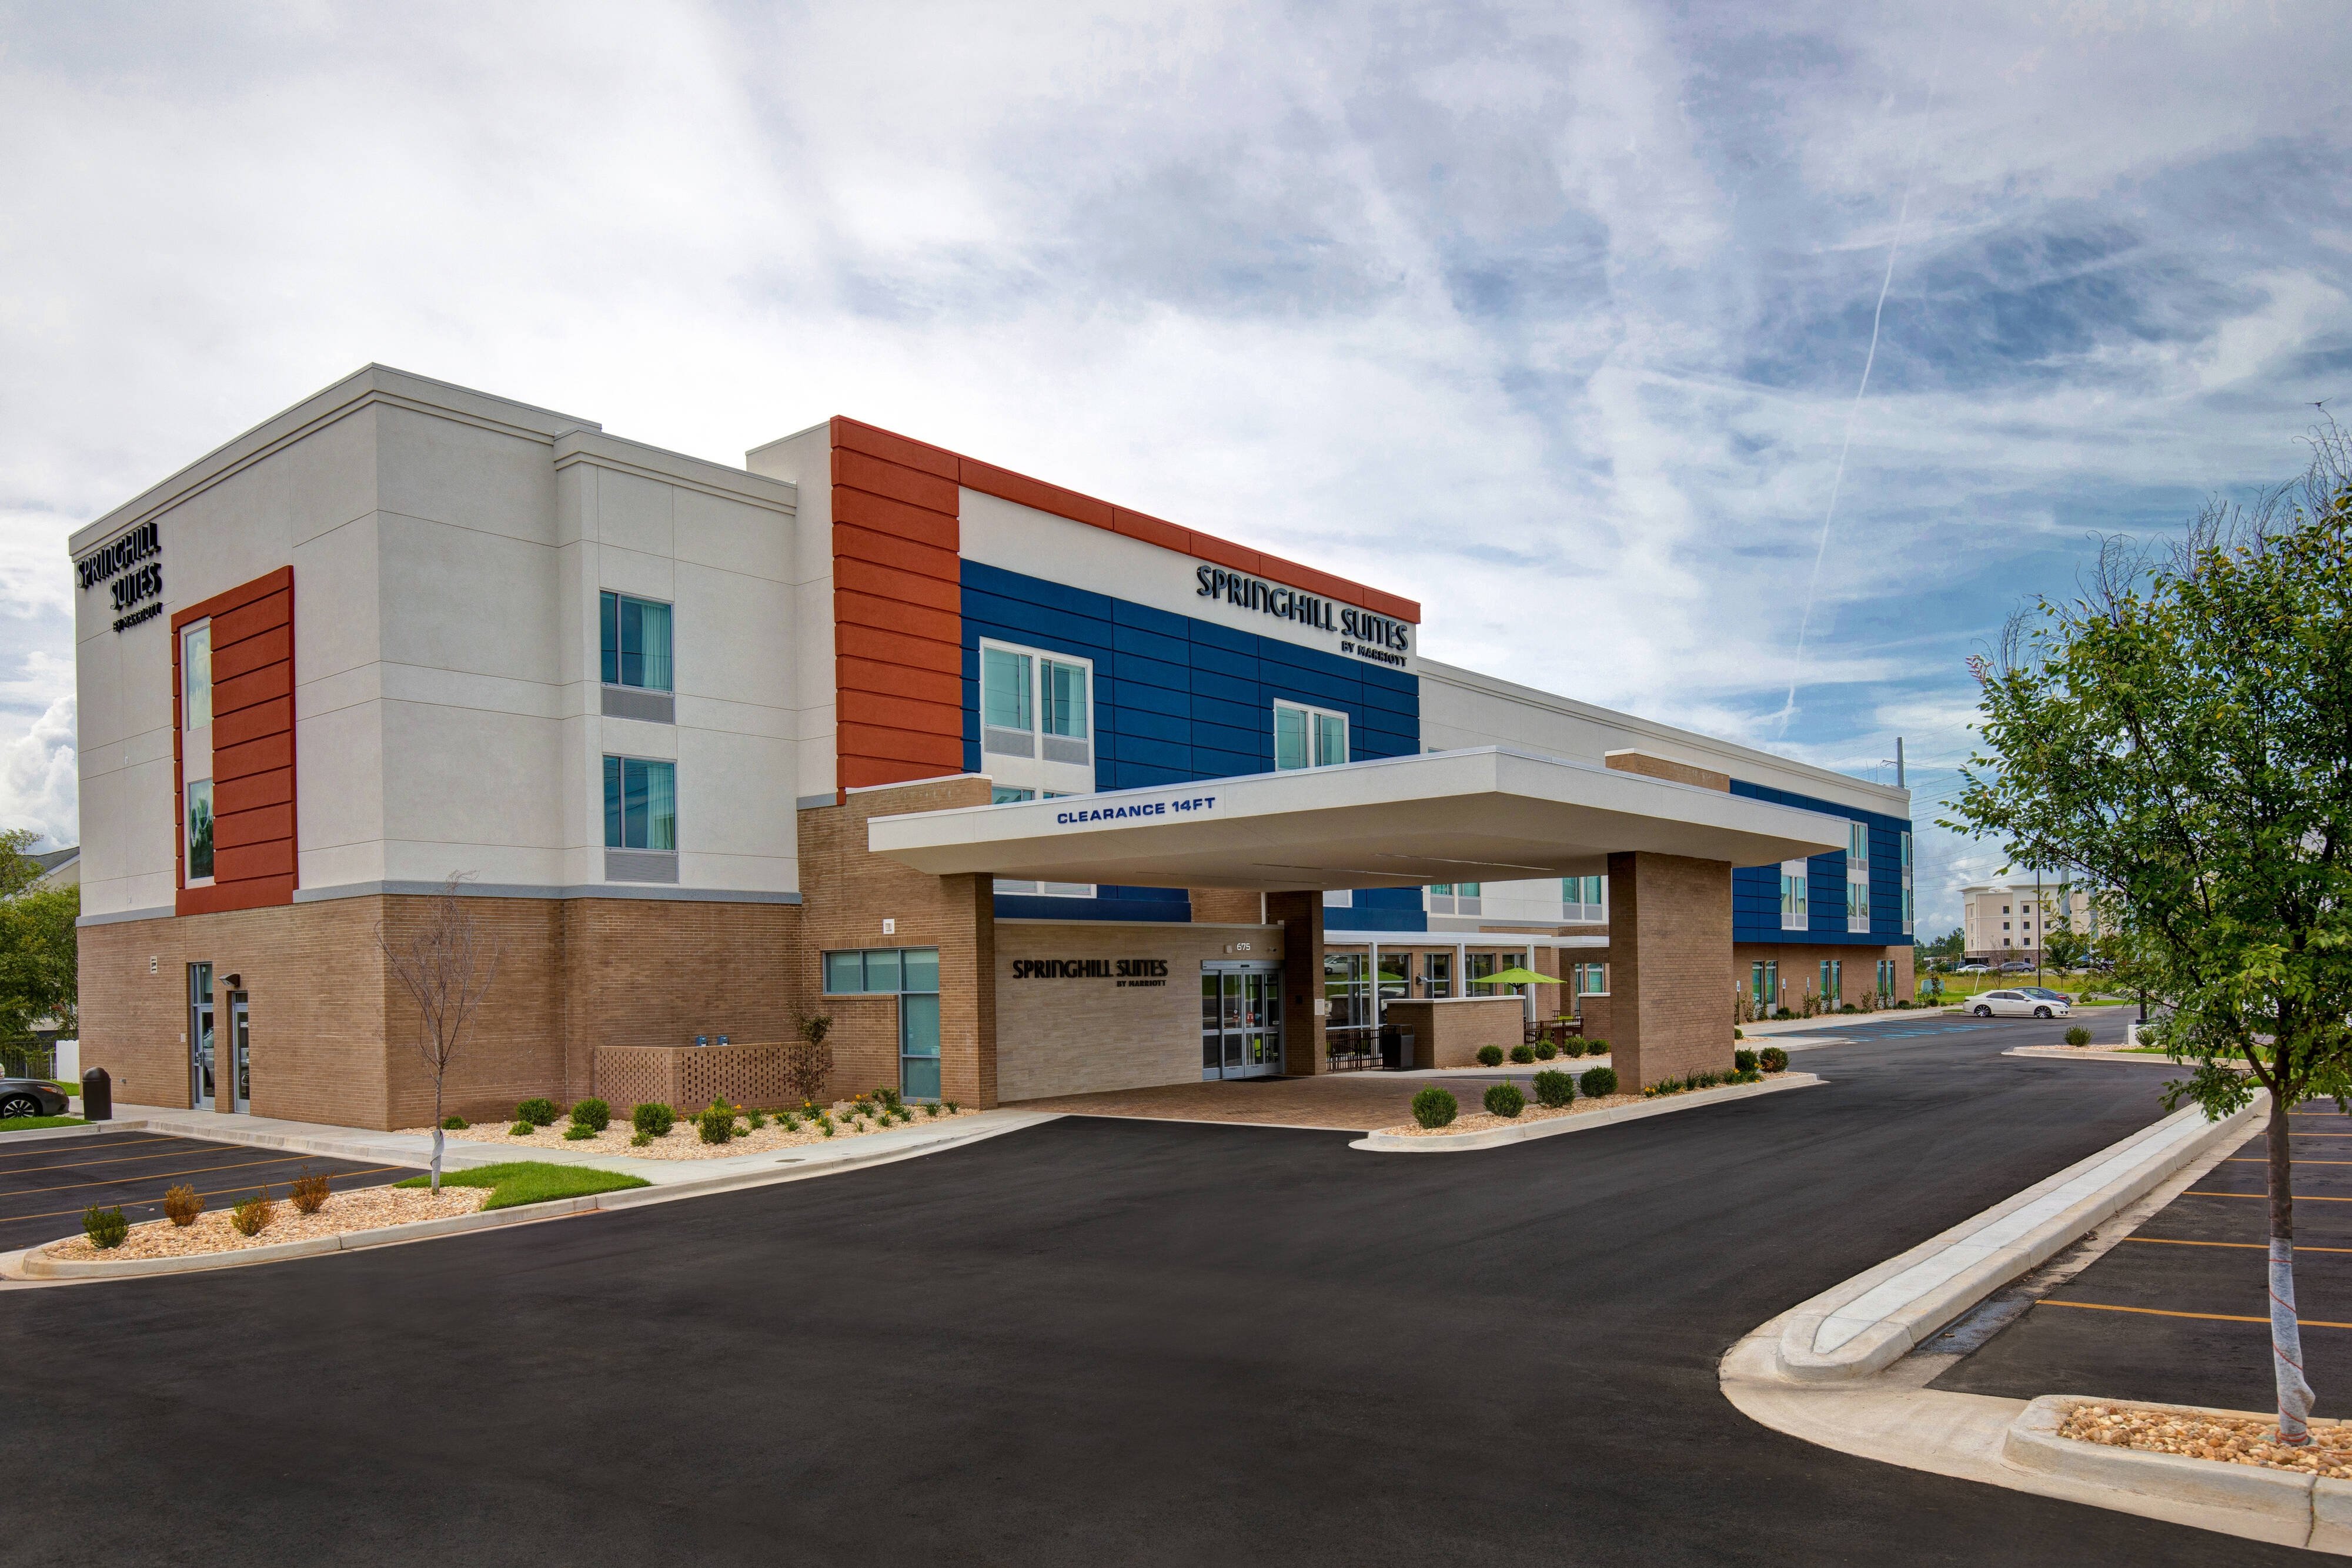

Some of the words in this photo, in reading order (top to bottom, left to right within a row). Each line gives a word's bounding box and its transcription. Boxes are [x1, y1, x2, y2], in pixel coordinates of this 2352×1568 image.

[77, 522, 161, 588] SPRINGHILL
[110, 561, 162, 610] SUITES
[1197, 565, 1338, 631] SPRINGHILL
[1341, 608, 1408, 650] SUITES
[1341, 640, 1355, 653] BY
[1357, 645, 1407, 667] MARRIOTT
[1057, 802, 1165, 824] CLEARANCE
[1171, 797, 1215, 813] 14FT
[1237, 942, 1251, 951] 675
[1012, 959, 1114, 978] SPRINGHILL
[1116, 959, 1168, 977] SUITES
